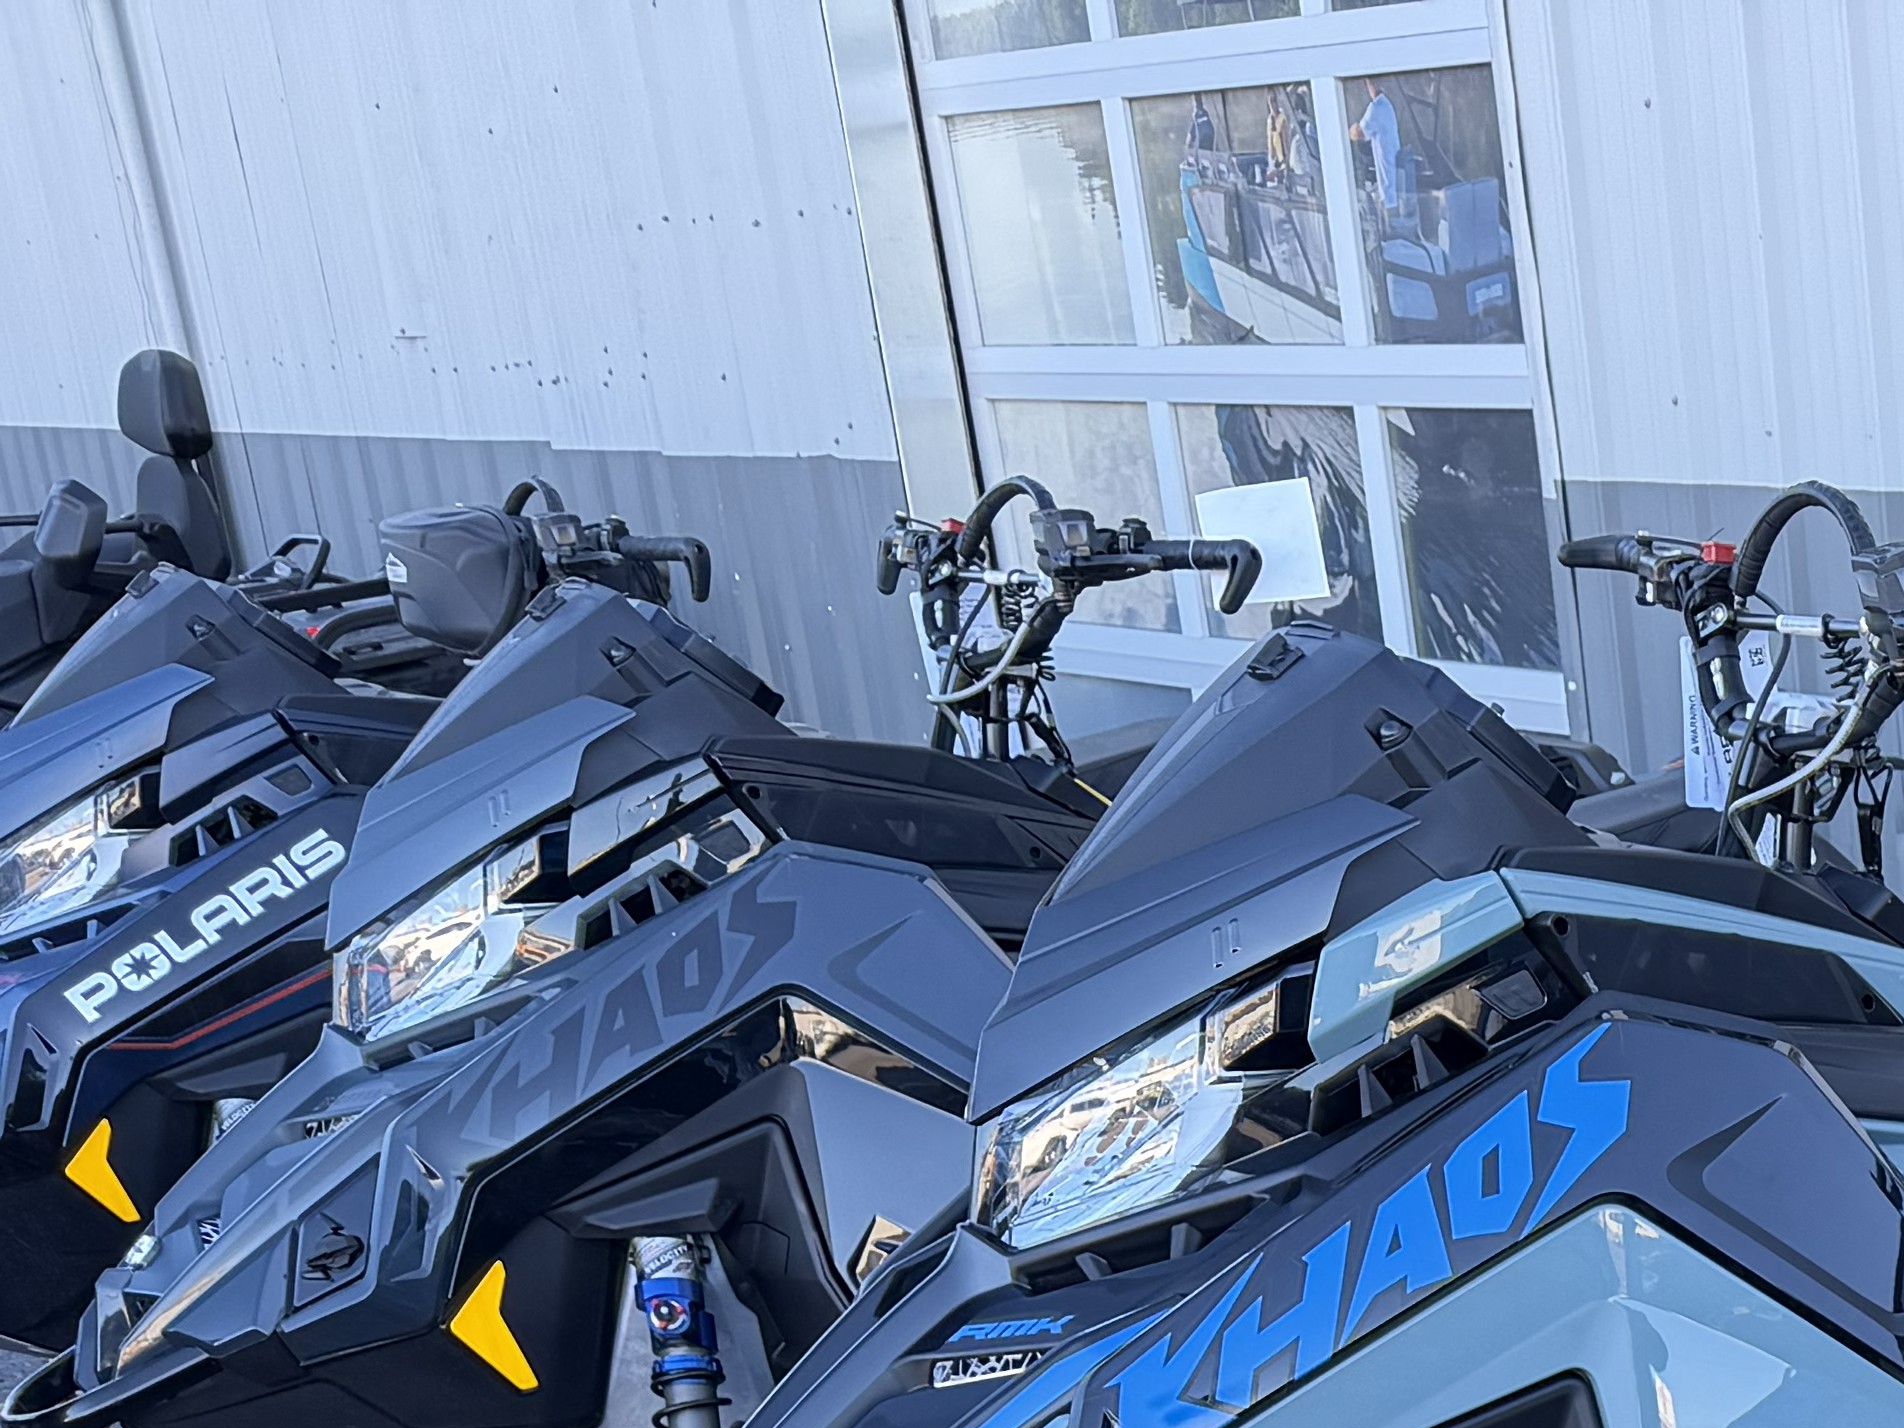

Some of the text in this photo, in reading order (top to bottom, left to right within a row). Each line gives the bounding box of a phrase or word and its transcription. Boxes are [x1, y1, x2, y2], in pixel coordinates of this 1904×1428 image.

[64, 829, 346, 1021] POLARIS
[404, 866, 798, 1205] KHAOS
[950, 1314, 1077, 1343] RMK
